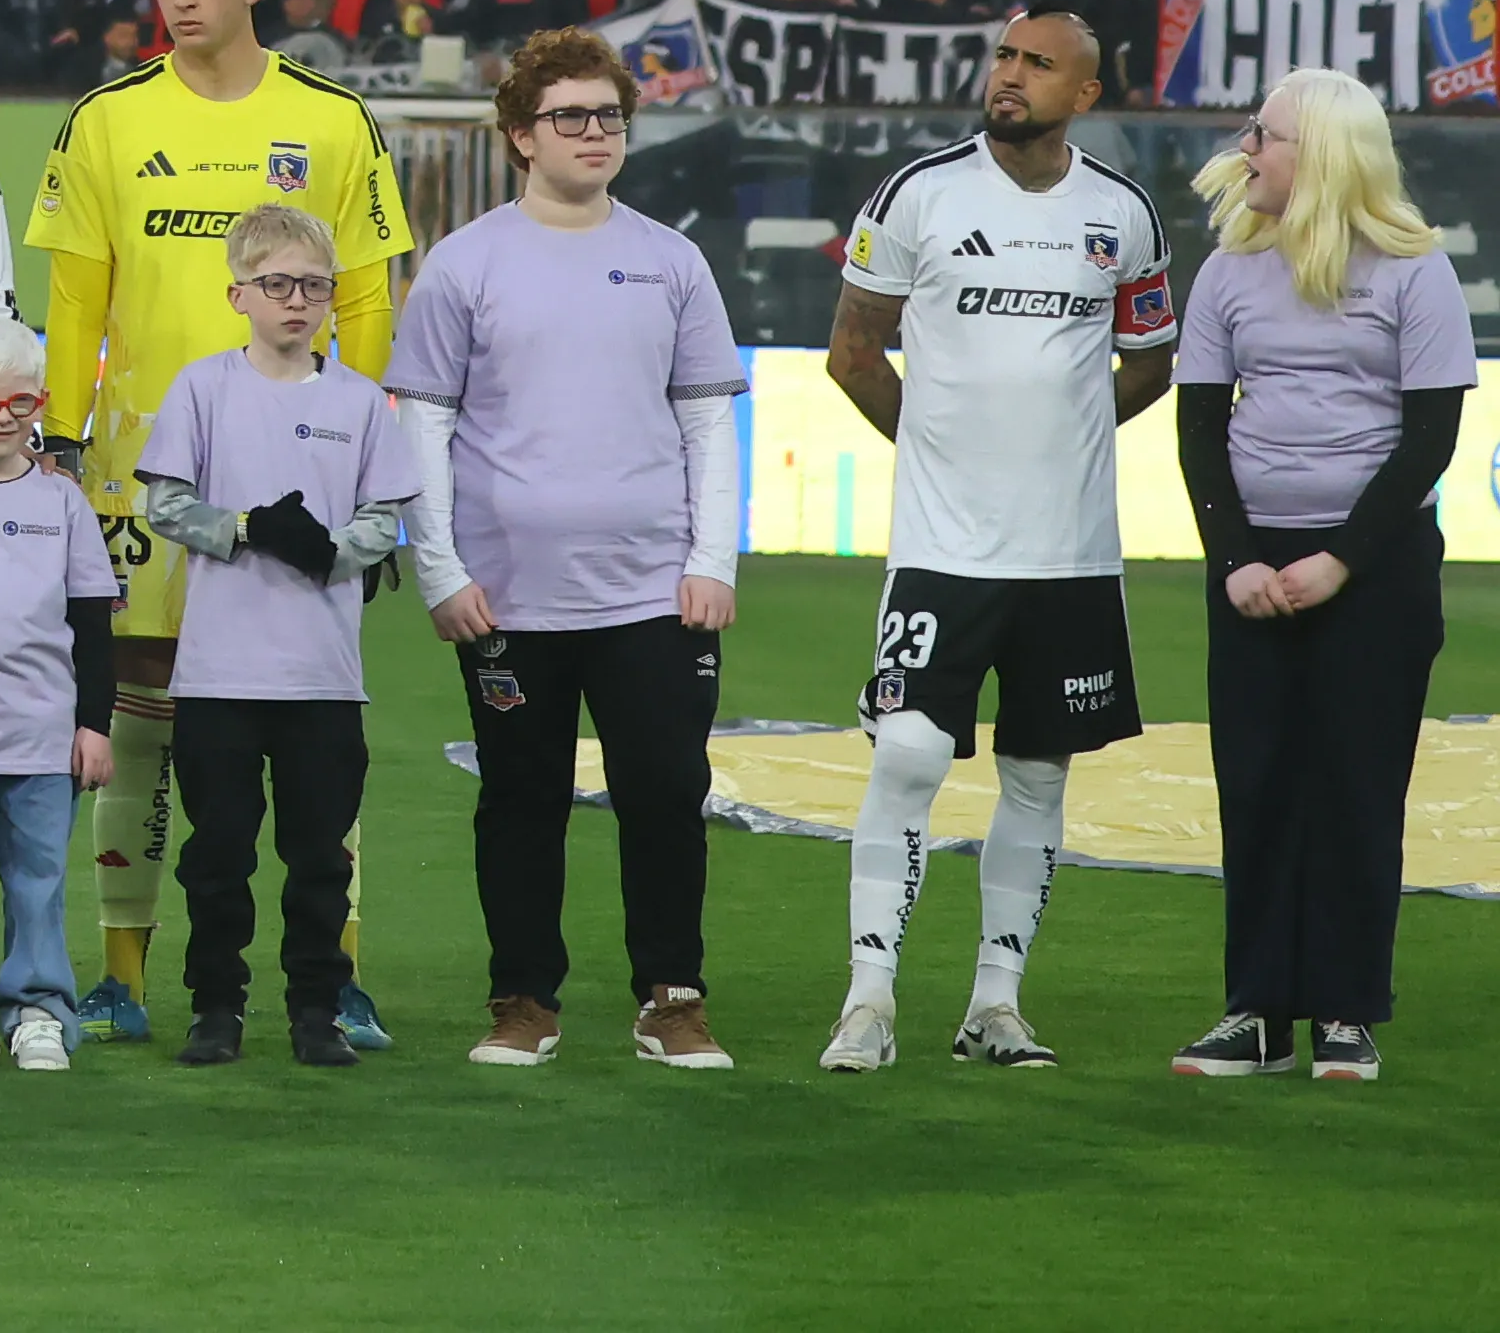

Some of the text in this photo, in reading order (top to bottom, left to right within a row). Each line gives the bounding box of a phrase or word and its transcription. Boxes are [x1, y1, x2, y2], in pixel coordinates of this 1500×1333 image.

[187, 163, 260, 172] JETOUR
[1001, 240, 1075, 252] JETOUR
[877, 611, 939, 670] 23
[1066, 697, 1099, 714] TV &
